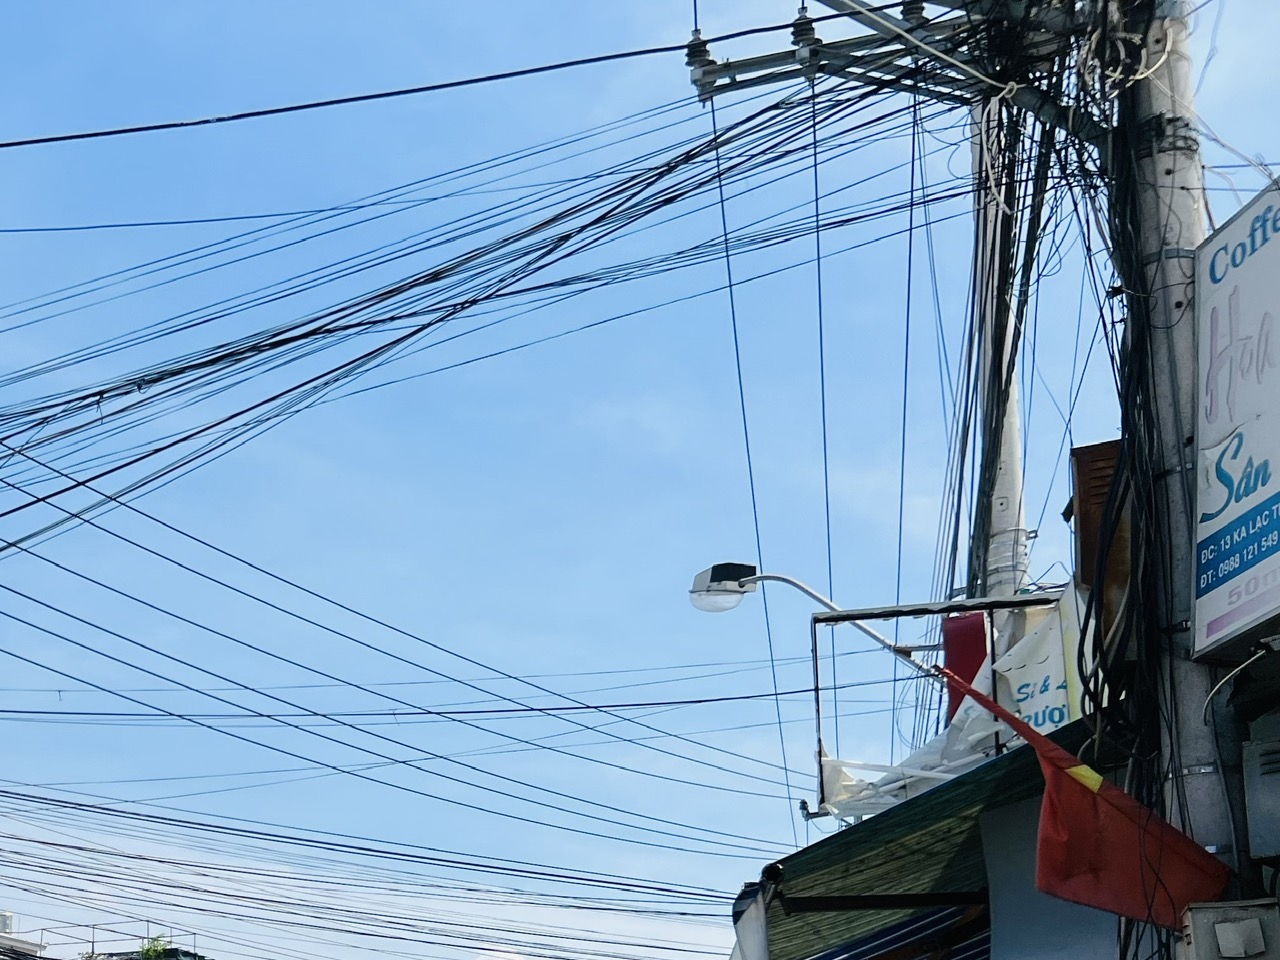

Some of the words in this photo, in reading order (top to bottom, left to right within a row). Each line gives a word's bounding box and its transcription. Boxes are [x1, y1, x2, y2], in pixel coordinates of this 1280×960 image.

[1199, 431, 1271, 523] Sân
[1200, 570, 1216, 588] ĐT:
[1218, 554, 1240, 577] 0988
[1243, 542, 1258, 561] 121
[1261, 531, 1278, 551] 549
[1201, 545, 1218, 563] ĐC:
[1220, 535, 1231, 551] 13
[1233, 526, 1247, 543] KA
